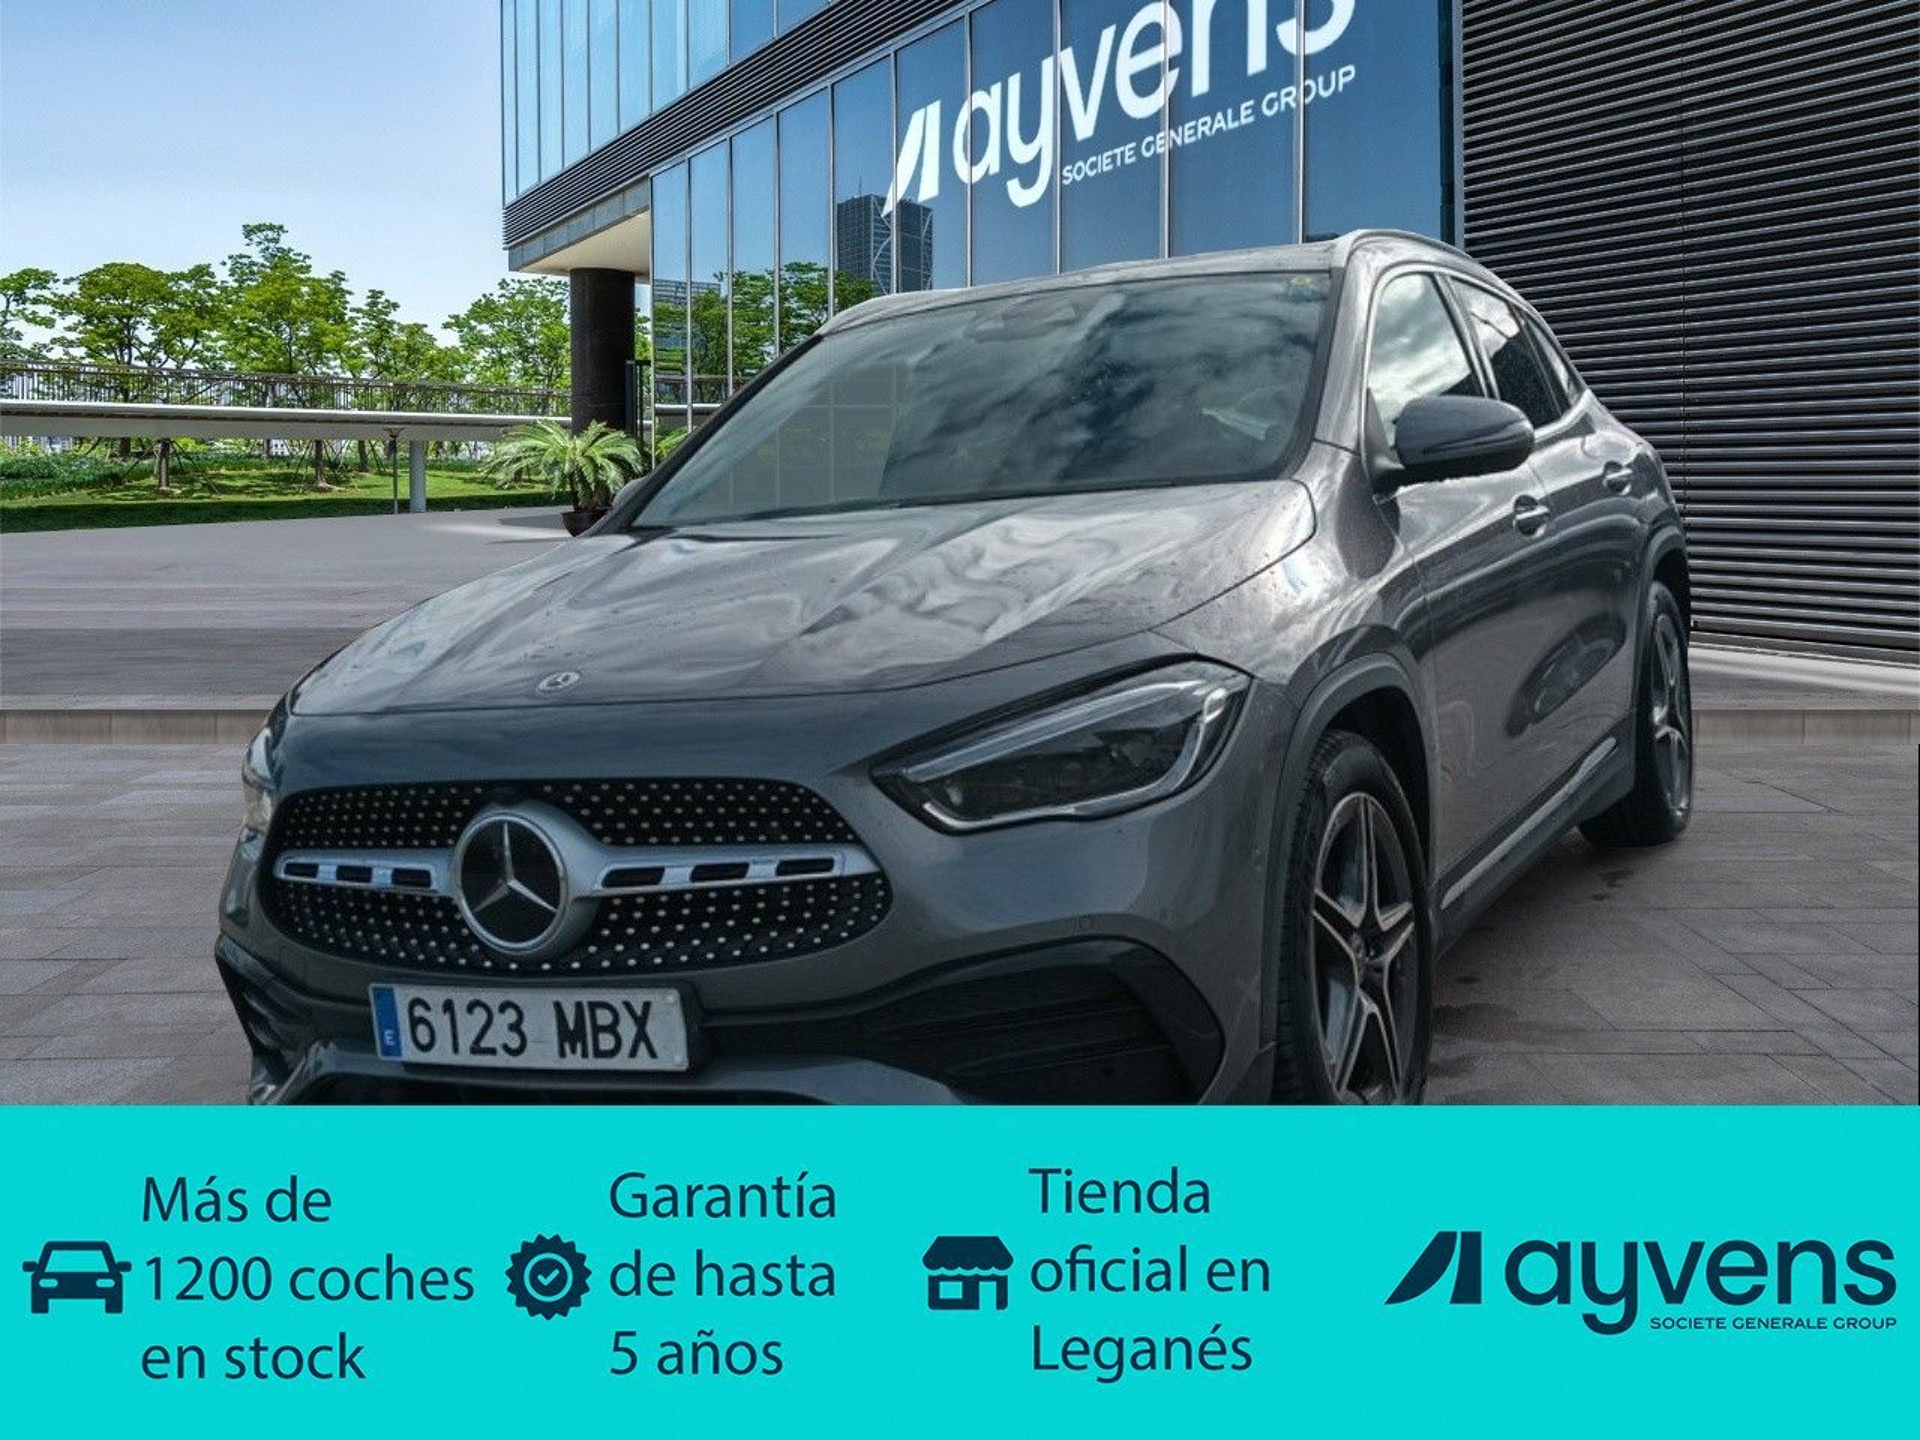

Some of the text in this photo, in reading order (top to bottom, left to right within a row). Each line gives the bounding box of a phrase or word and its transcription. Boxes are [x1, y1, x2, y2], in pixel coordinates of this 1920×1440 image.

[1061, 64, 1356, 186] SOCIETE GENERALE GROUP
[407, 997, 658, 1059] 6123 MBX
